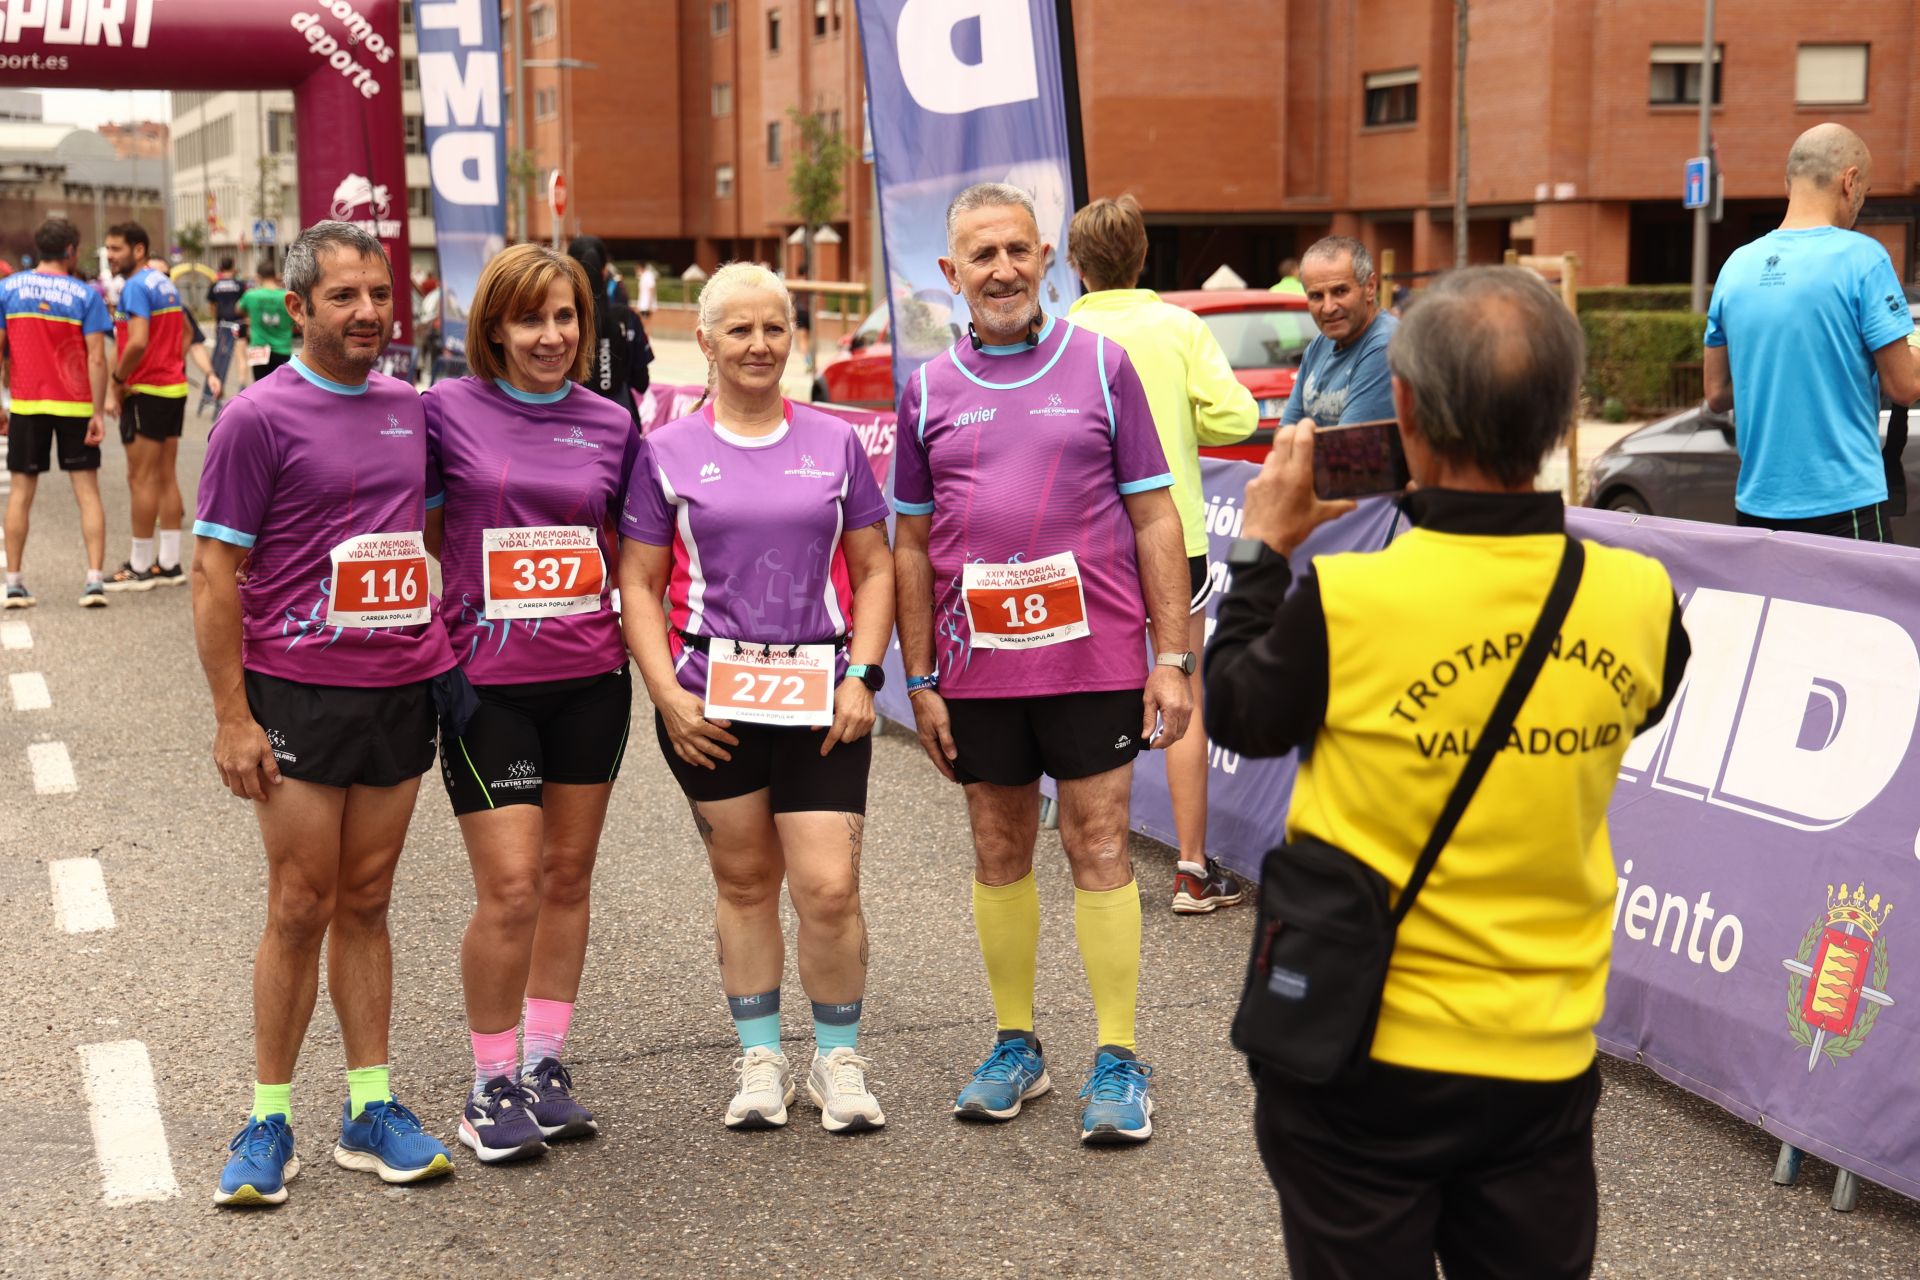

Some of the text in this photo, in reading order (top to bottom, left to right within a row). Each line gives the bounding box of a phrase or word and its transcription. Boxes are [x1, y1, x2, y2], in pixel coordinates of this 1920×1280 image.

[290, 12, 381, 99] deporte
[953, 406, 997, 427] Javier
[499, 538, 591, 548] VIDAL-MATARRANZ
[509, 530, 581, 540] XXIX MEMORIAL
[348, 547, 421, 559] VIDAL-MATARRANZ
[357, 539, 416, 550] XXIX MEMORIAL
[512, 556, 582, 592] 337
[976, 568, 1067, 587] VIDAL-MATARRANZ
[986, 563, 1056, 579] XXIX MEMORIAL
[360, 566, 417, 604] 116
[1001, 593, 1048, 628] 18
[1027, 632, 1055, 642] POPULAR
[722, 653, 820, 667] VIDAL-MATARRANZ
[731, 672, 805, 705] 272
